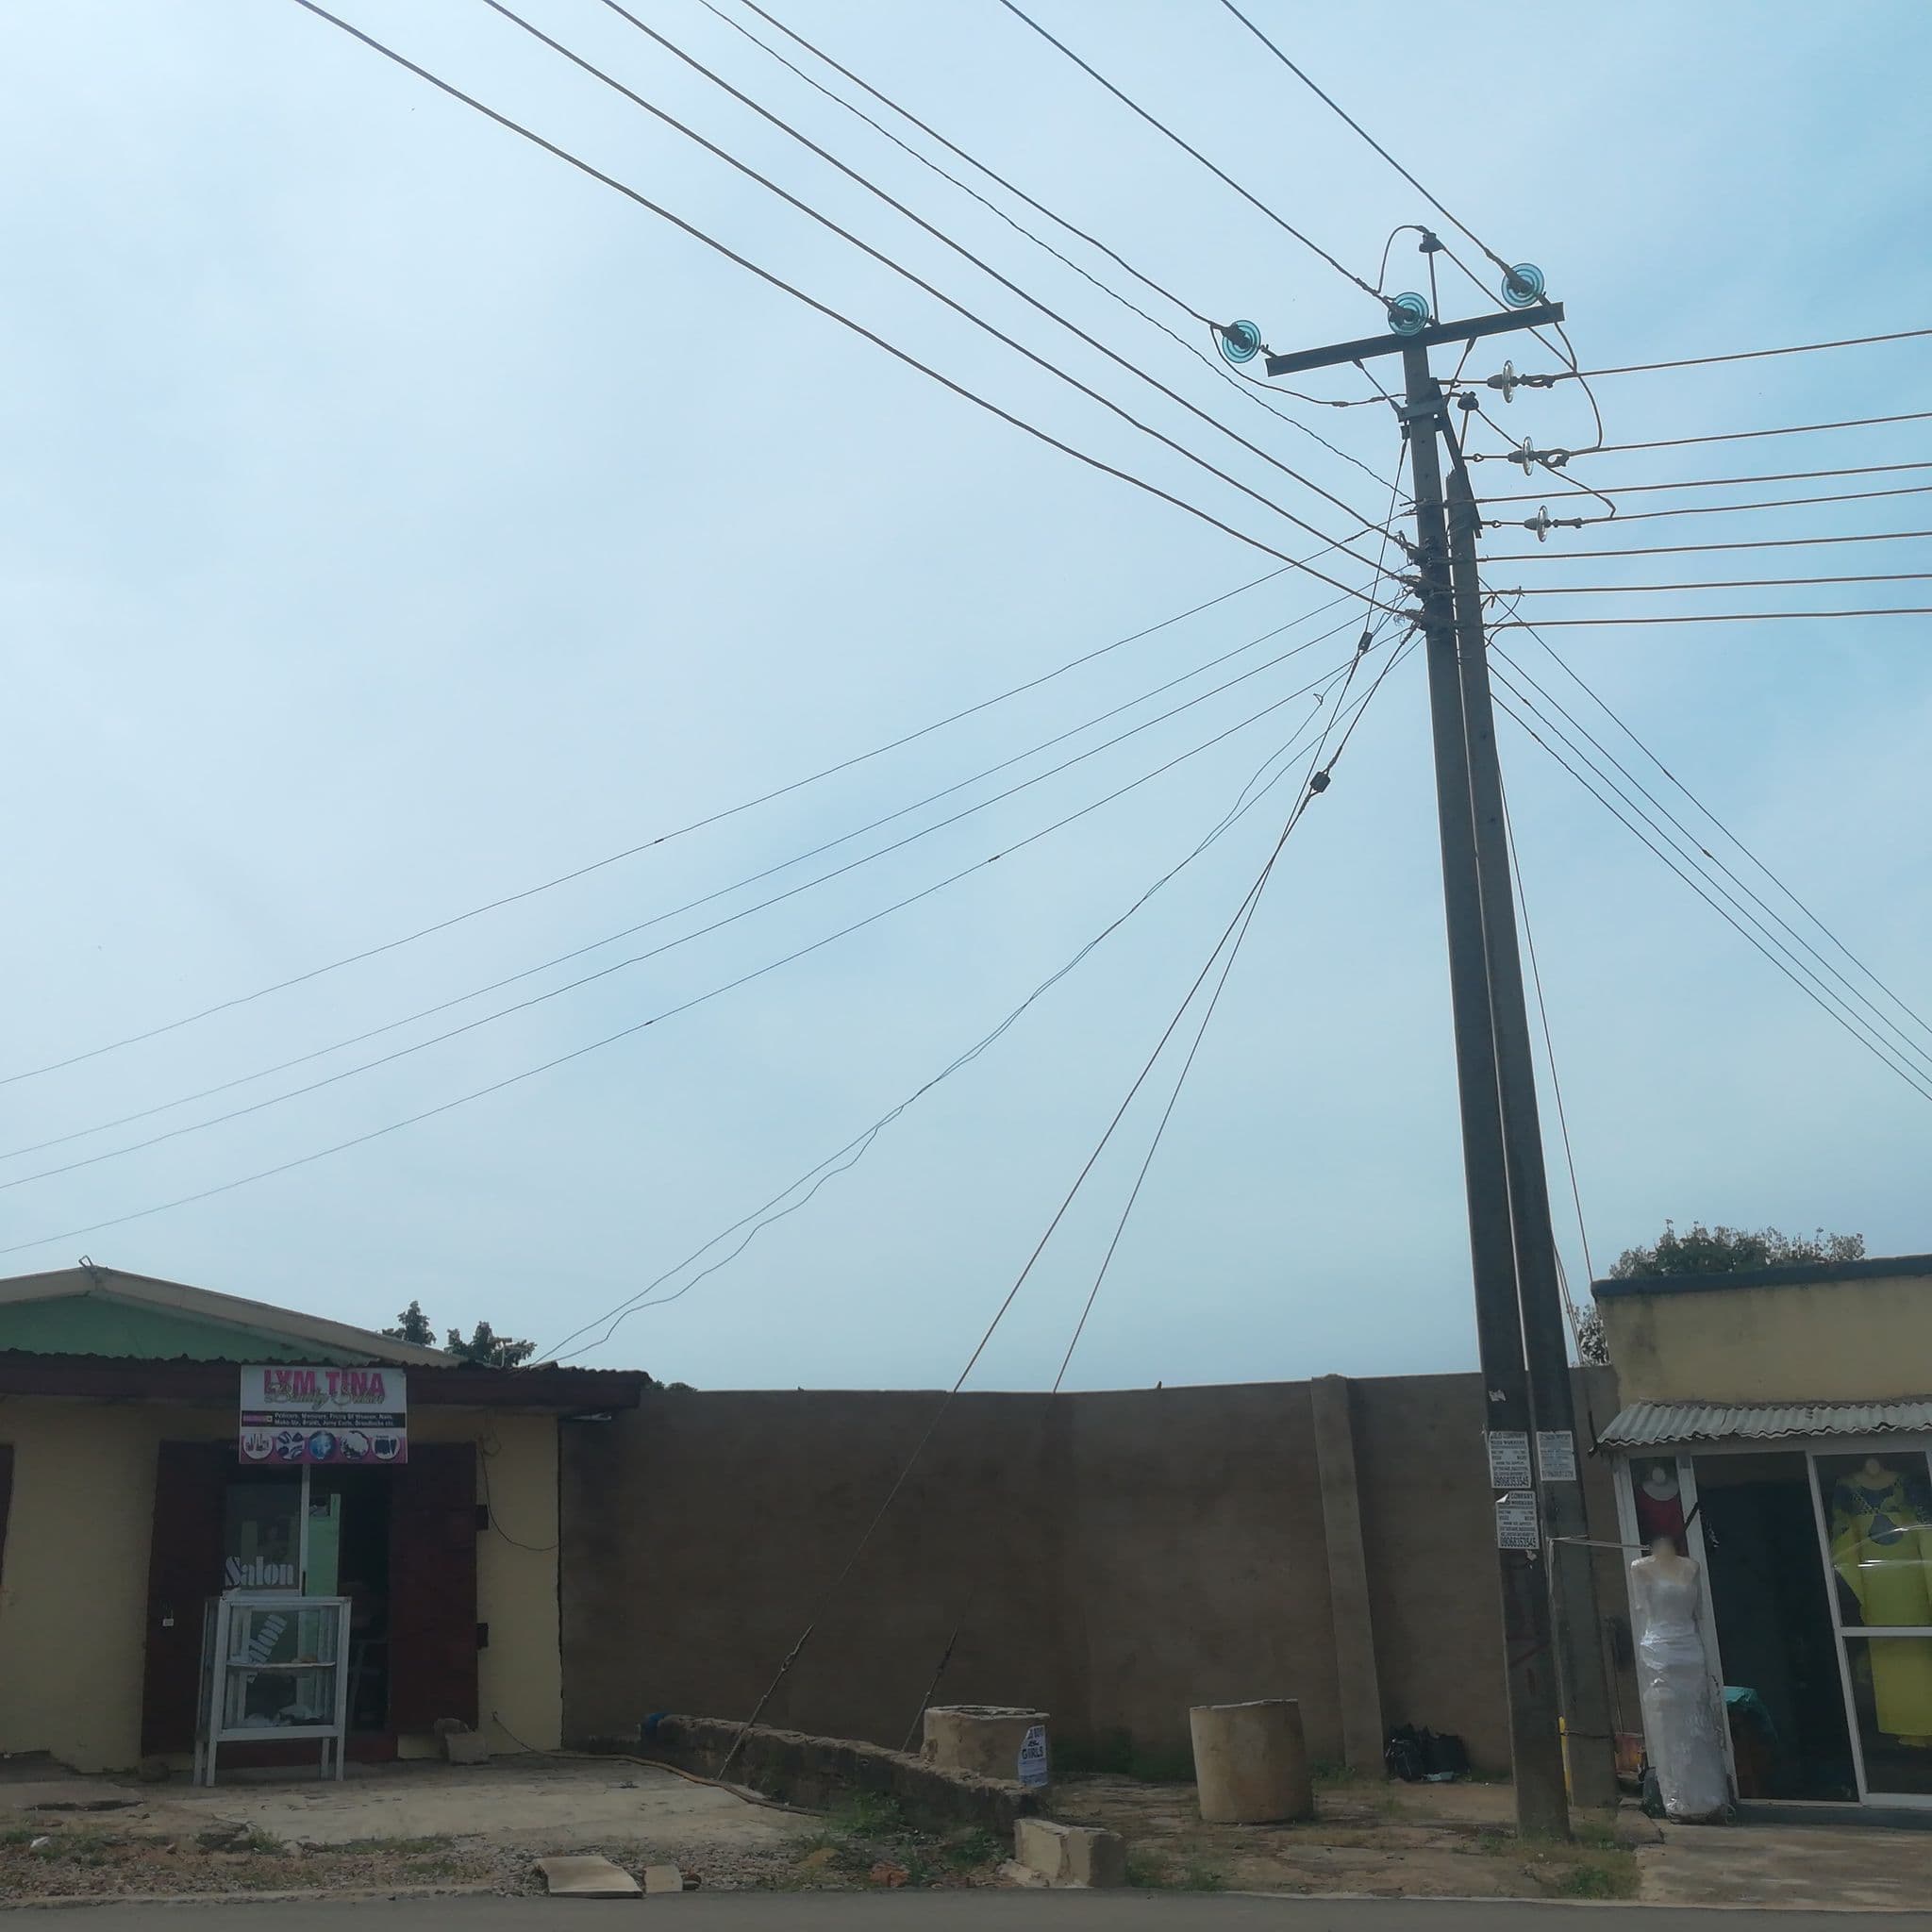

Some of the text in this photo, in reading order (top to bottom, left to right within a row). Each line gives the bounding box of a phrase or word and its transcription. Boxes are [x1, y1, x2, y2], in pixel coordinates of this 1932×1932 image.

[264, 1369, 385, 1397] LYM TINA
[225, 1556, 294, 1586] Salon
[1022, 1745, 1043, 1759] GIRLS
